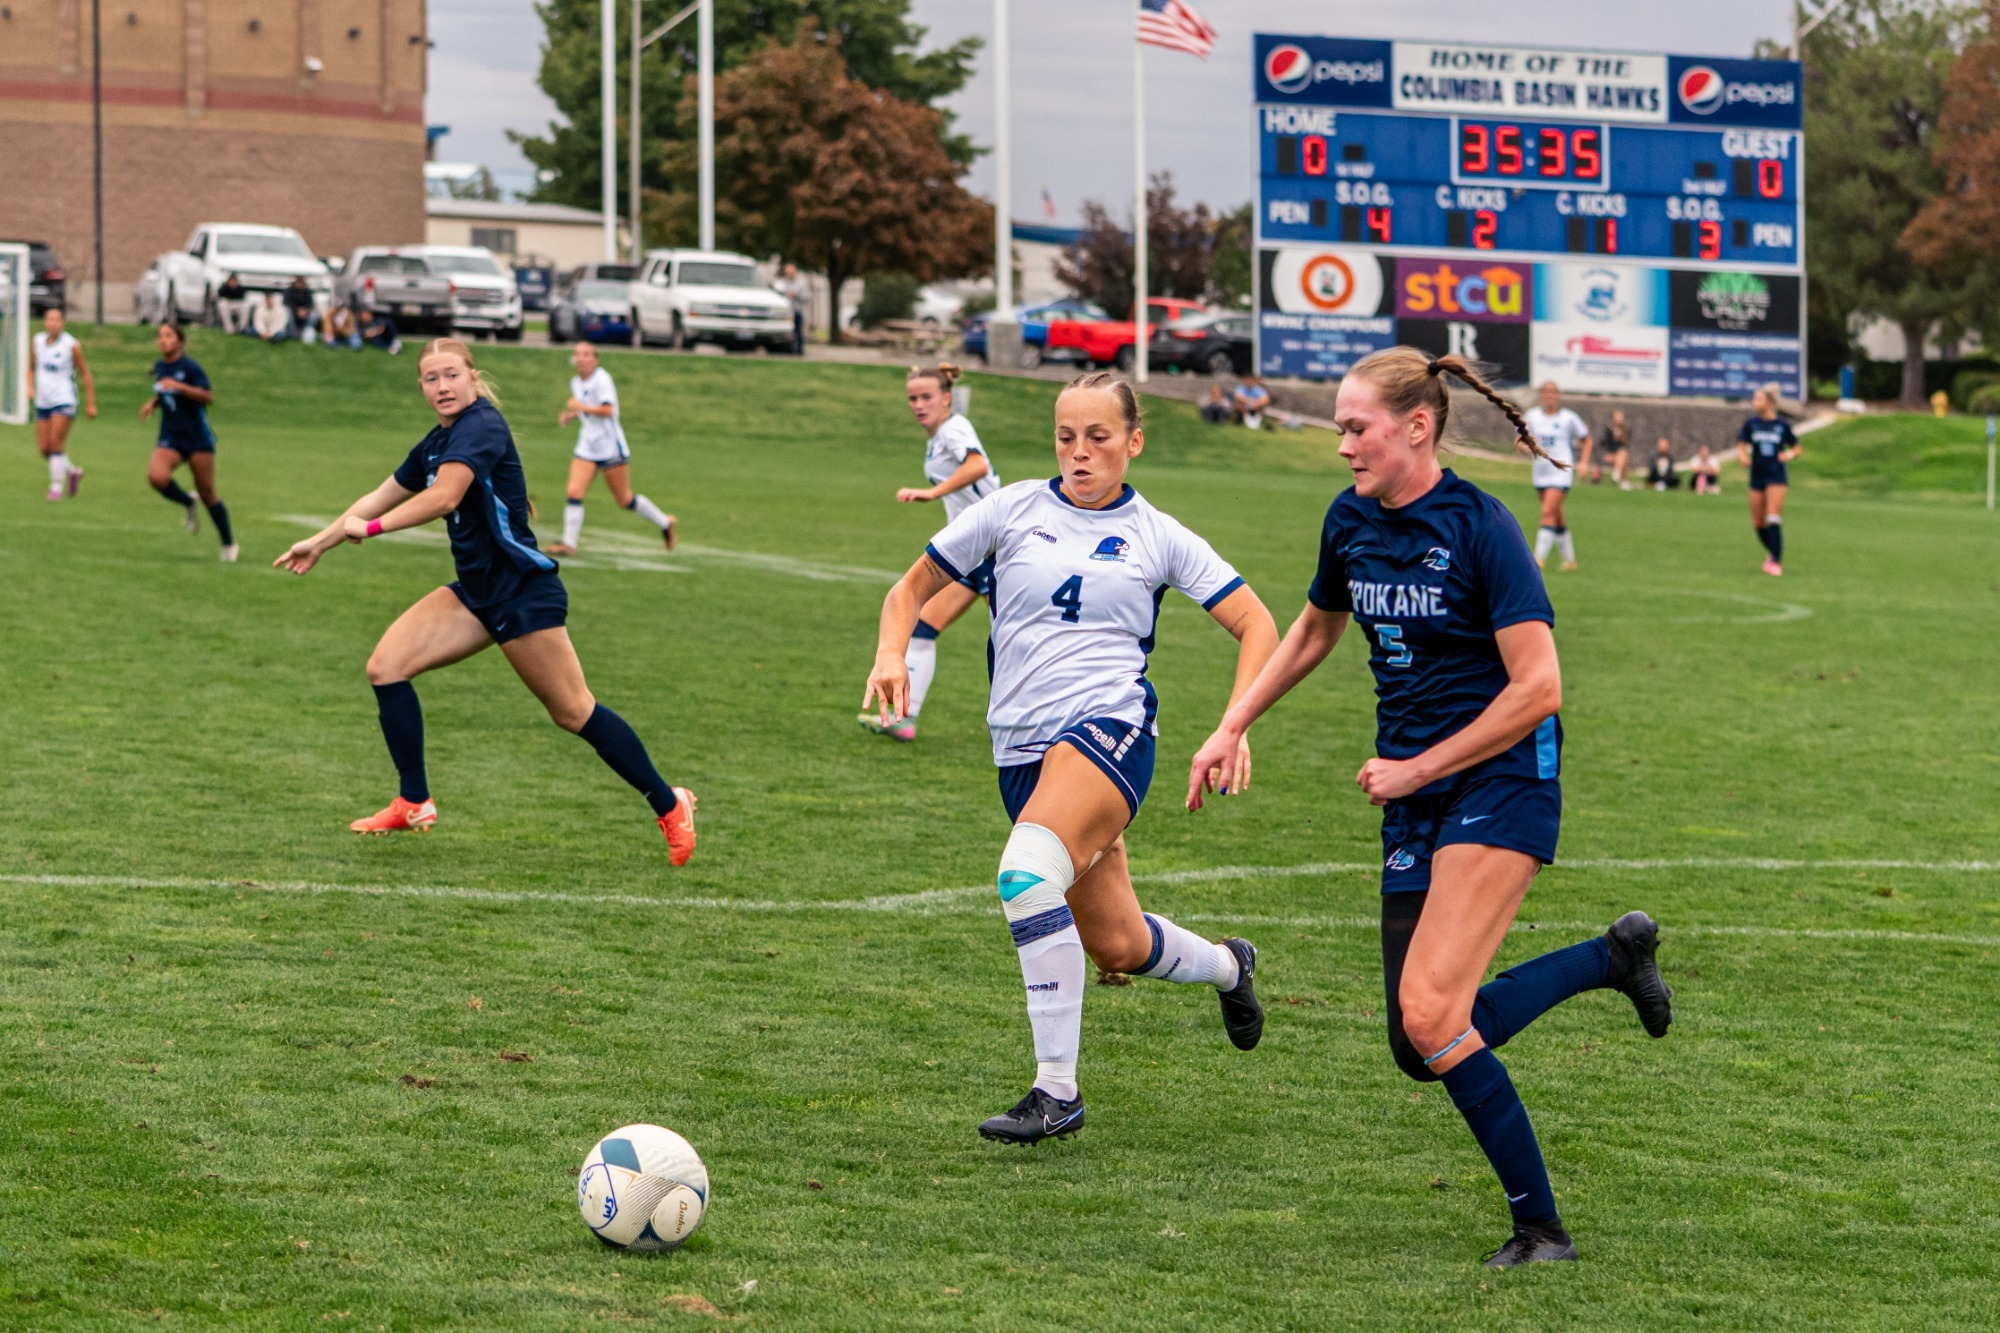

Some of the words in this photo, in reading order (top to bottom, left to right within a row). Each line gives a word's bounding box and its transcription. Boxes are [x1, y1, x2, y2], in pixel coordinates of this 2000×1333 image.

[1313, 59, 1384, 86] pepsi
[1430, 49, 1516, 72] HOME
[1525, 55, 1563, 75] OF
[1576, 57, 1632, 78] THE
[1401, 75, 1505, 104] COLUMBIA
[1515, 81, 1577, 108] BASIN
[1587, 85, 1660, 112] HAWKS
[1725, 80, 1795, 107] pepsi
[1264, 108, 1337, 136] HOME
[1302, 135, 1327, 176] 0
[1463, 125, 1601, 179] 35:35
[1722, 129, 1793, 160] GUEST
[1335, 180, 1394, 206] S.O.G.
[1758, 159, 1783, 198] 0
[1268, 201, 1310, 224] PEN
[1435, 185, 1454, 209] C.
[1457, 187, 1507, 211] KICKS
[1556, 192, 1575, 215] C.
[1577, 193, 1627, 217] KICKS
[1666, 196, 1724, 221] S.O.G.
[1367, 207, 1391, 243] 4
[1472, 210, 1497, 250] 2
[1606, 218, 1617, 254] 1
[1752, 222, 1793, 248] PEN
[1699, 220, 1721, 261] 3
[1405, 263, 1523, 316] stcu
[1447, 321, 1480, 360] R
[1032, 530, 1057, 542] capelli
[1089, 553, 1128, 562] CBC
[1051, 574, 1083, 624] 4
[1374, 623, 1413, 667] 5
[1083, 723, 1117, 750] capelli
